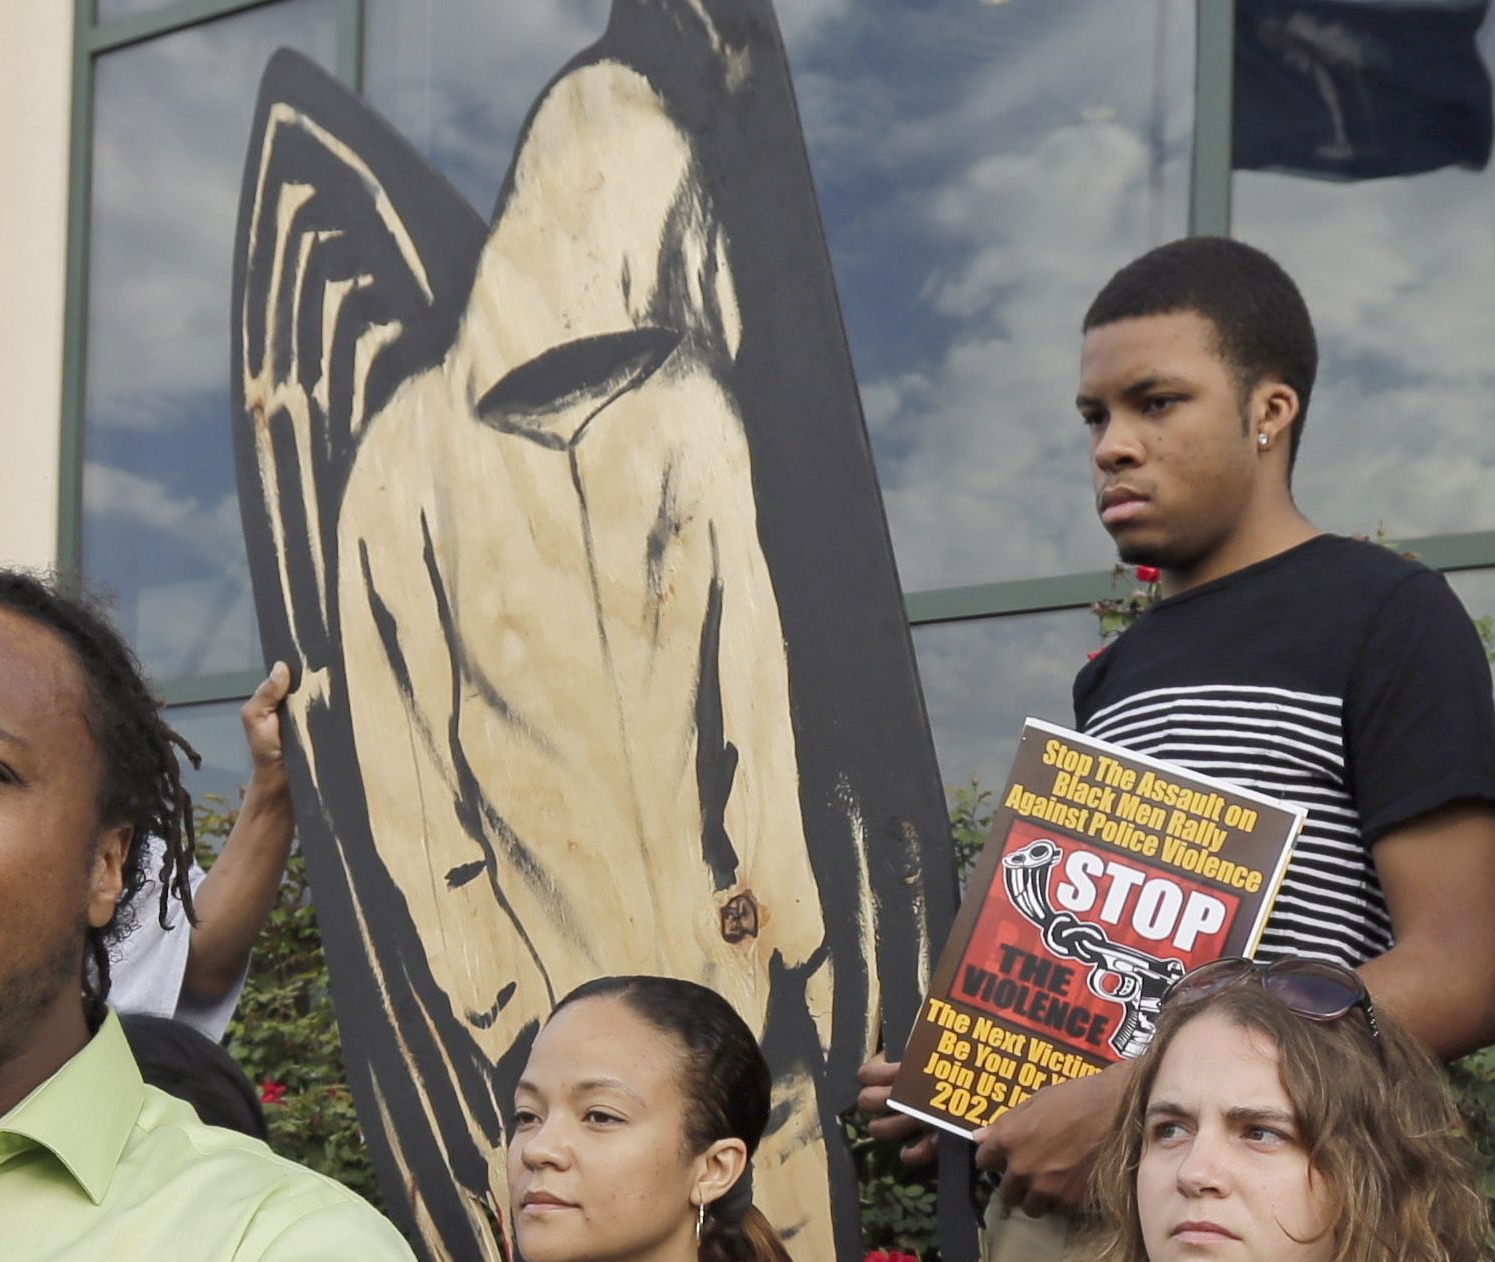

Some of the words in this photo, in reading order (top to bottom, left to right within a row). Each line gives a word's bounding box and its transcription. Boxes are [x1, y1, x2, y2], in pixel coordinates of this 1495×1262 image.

[1042, 739, 1094, 777] Stop
[1096, 756, 1137, 791] The
[1136, 771, 1221, 822] Assault
[1223, 804, 1258, 834] on
[1051, 772, 1115, 814] Black
[1116, 793, 1168, 831] Men
[1166, 809, 1229, 853] Rally
[1005, 783, 1089, 832] Against
[1087, 813, 1160, 856] Police
[1159, 835, 1265, 894] Violence
[1055, 849, 1227, 953] STOP
[961, 964, 1111, 1047] VIOLENCE
[999, 943, 1075, 998] THE
[926, 998, 972, 1034] The
[971, 1017, 1027, 1057] Next
[936, 1029, 972, 1061] Be
[974, 1046, 1018, 1080] You
[1018, 1062, 1048, 1091] Or
[923, 1053, 975, 1091] Join
[975, 1072, 1008, 1103] Us
